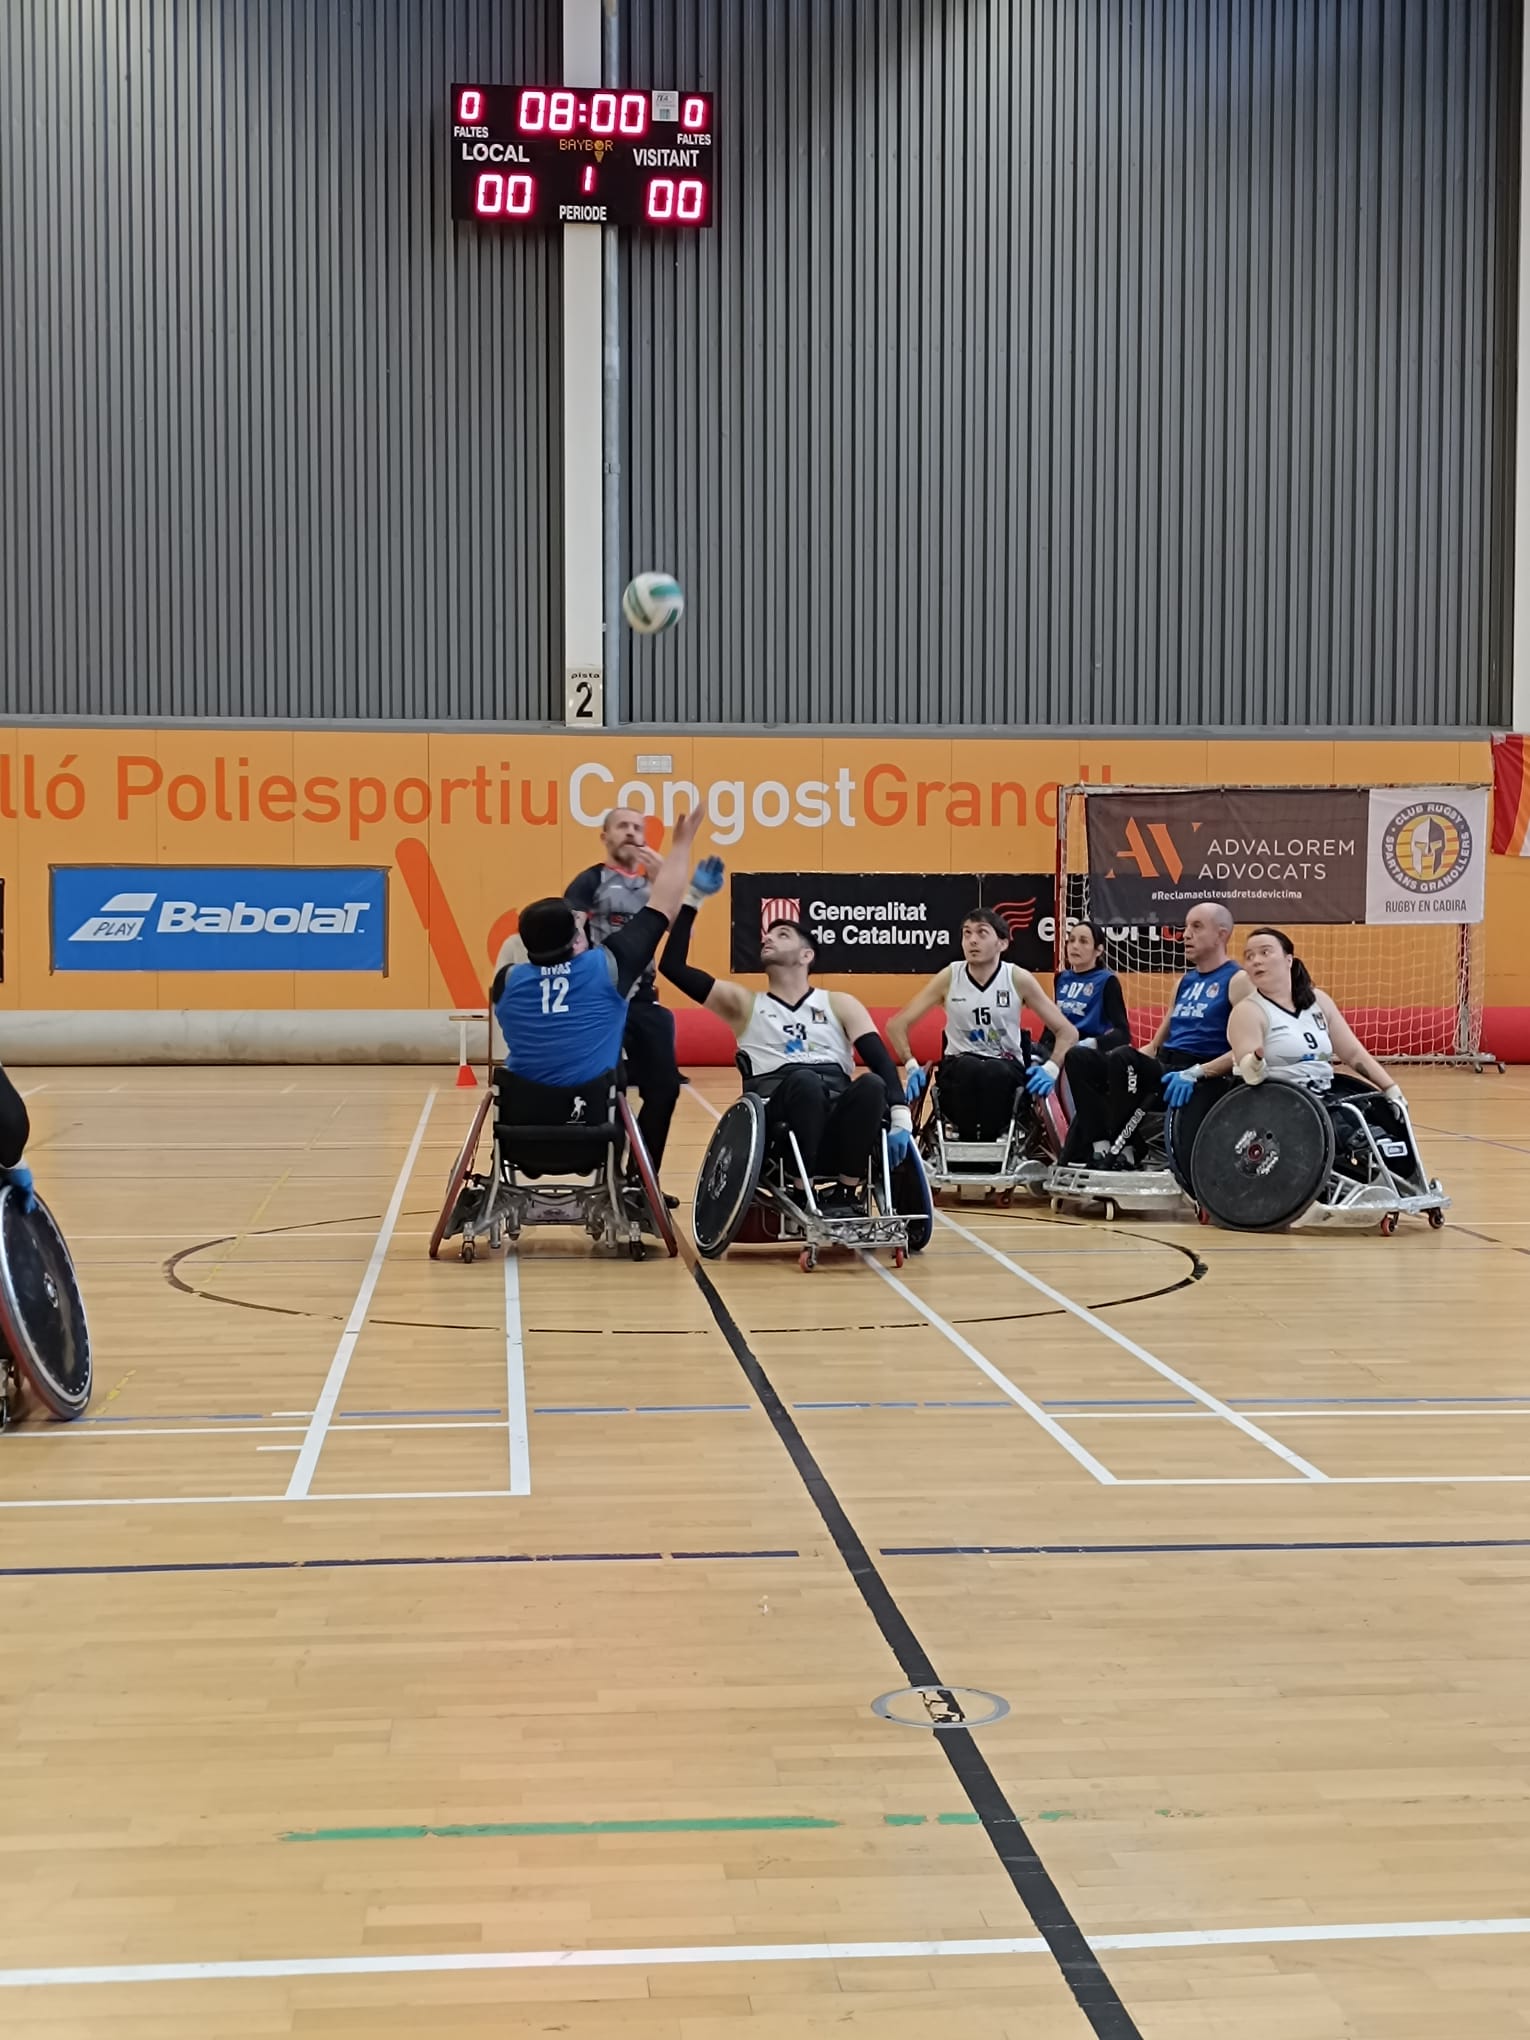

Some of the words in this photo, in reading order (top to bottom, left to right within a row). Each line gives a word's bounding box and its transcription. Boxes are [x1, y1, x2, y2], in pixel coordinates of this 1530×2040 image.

[460, 91, 480, 119] 0
[520, 91, 645, 133] 08:00
[684, 99, 704, 127] 0
[454, 126, 489, 138] FALTES
[677, 133, 711, 145] FALTES
[462, 143, 530, 162] LOCAL
[559, 139, 613, 151] BAYBOR
[633, 148, 699, 167] VISITANT
[477, 174, 532, 213] 00
[648, 180, 702, 218] 00
[559, 205, 607, 221] PERIODE
[576, 682, 593, 717] 2
[1395, 804, 1424, 826] CLUB
[1427, 804, 1463, 824] RUGBY
[1207, 839, 1355, 856] ADVALOREM
[1385, 835, 1418, 890] SPARTANS
[1420, 831, 1470, 892] GRANOLLERS
[1198, 863, 1326, 880] ADVOCATS
[1151, 889, 1303, 900] #Reclamaelsteusdretsdevictima
[809, 901, 927, 921] Generalitat
[1385, 900, 1416, 913] RUGBY
[1419, 900, 1431, 912] EN
[1433, 899, 1467, 912] CADIRA
[93, 921, 137, 936] PLAY
[842, 925, 950, 950] Catalunya
[539, 977, 570, 1014] 12
[1067, 982, 1085, 999] 07
[972, 1007, 992, 1026] 15
[1303, 1032, 1319, 1049] 9
